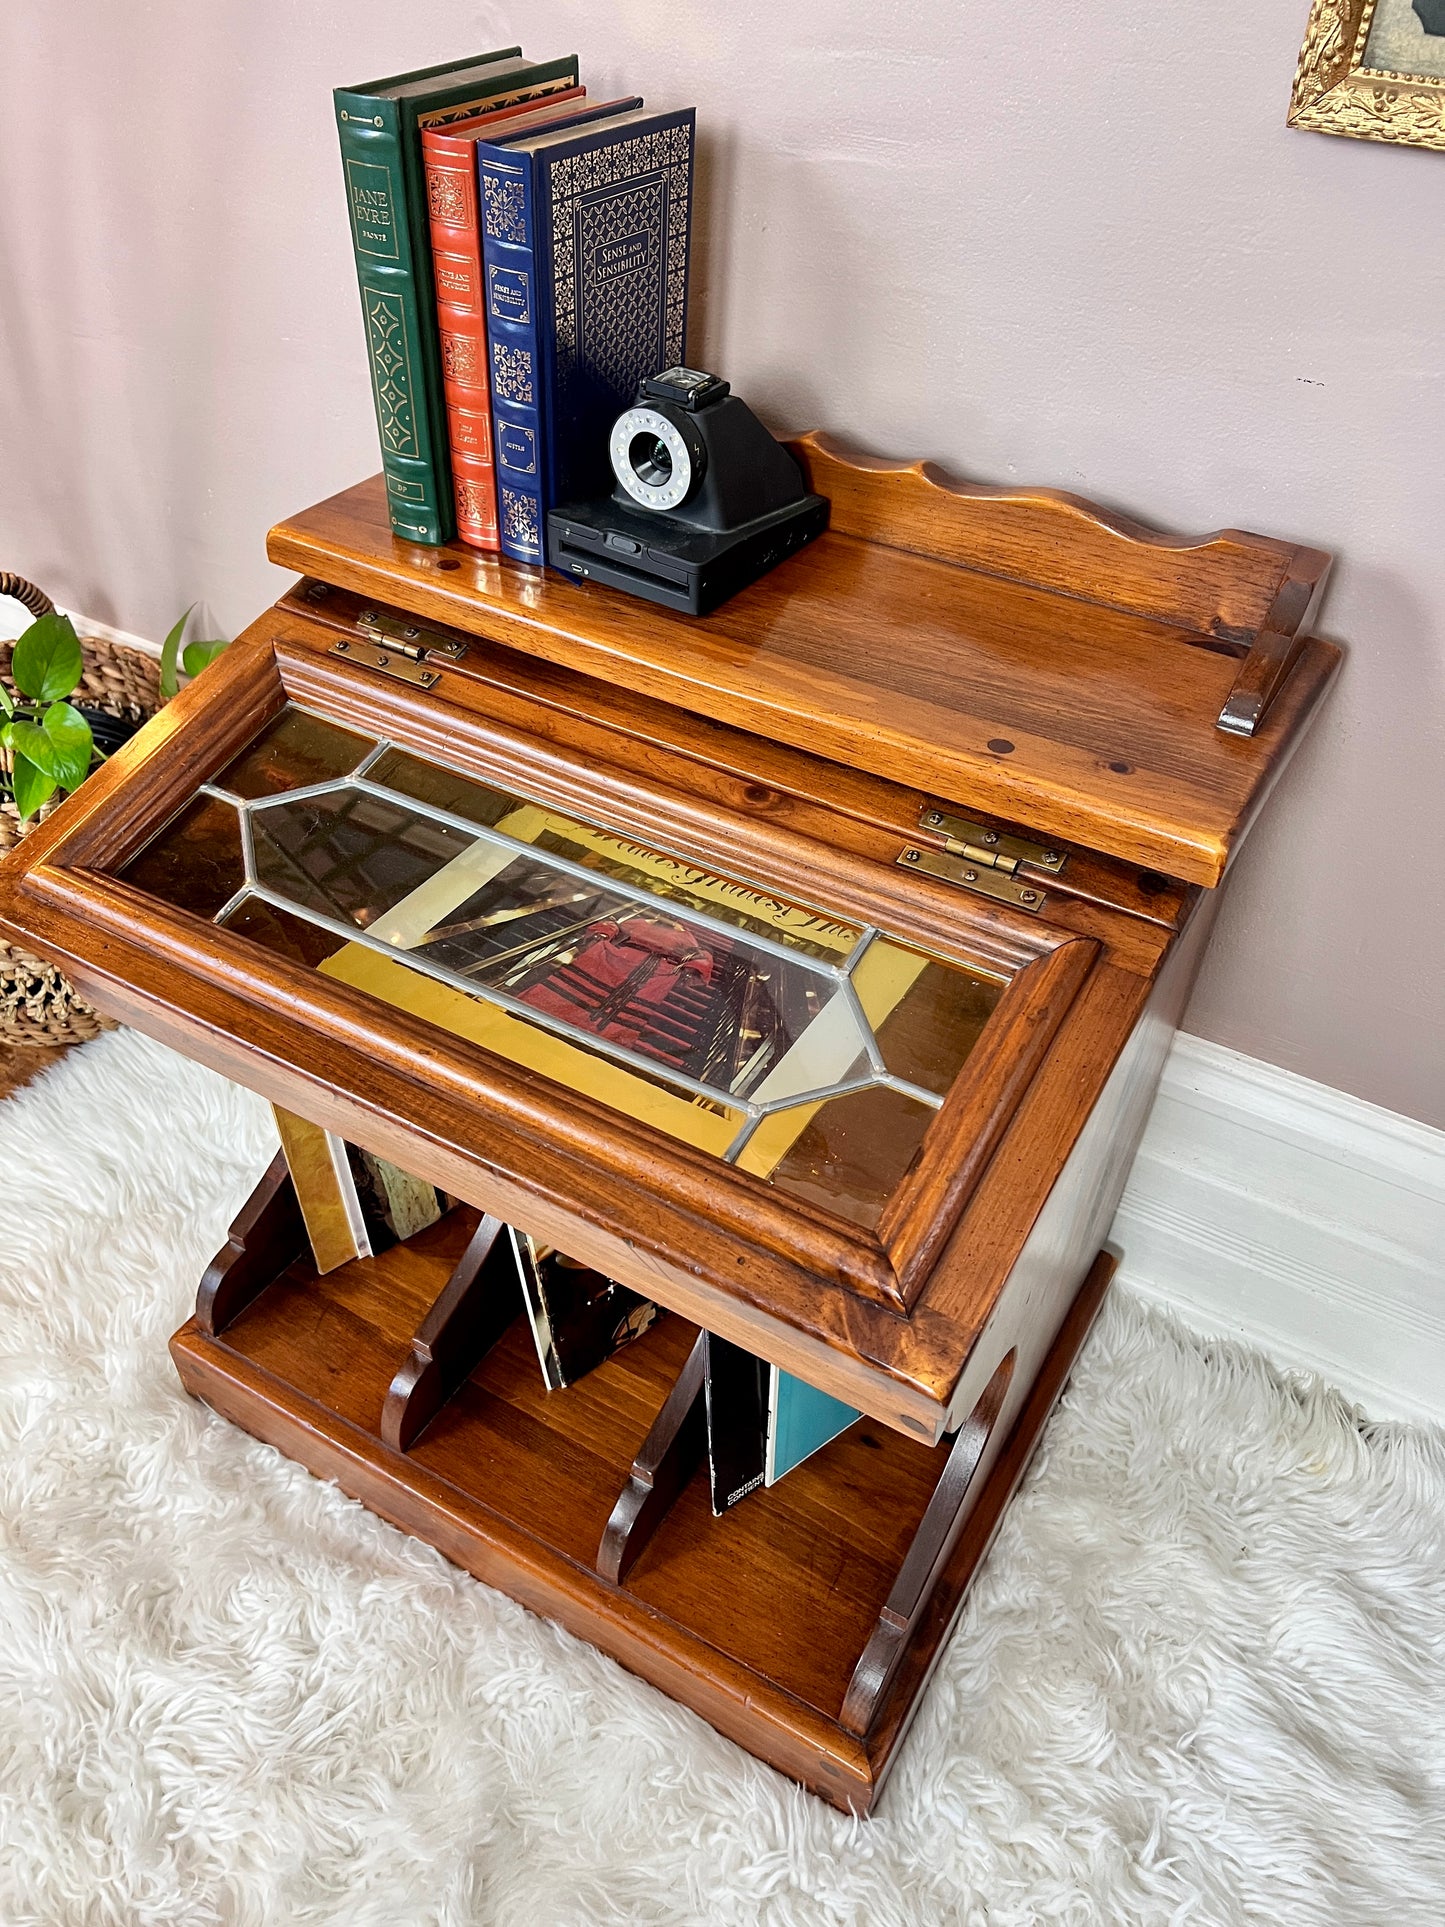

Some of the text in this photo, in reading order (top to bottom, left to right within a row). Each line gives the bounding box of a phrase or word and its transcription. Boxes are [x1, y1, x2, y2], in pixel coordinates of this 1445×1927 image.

[353, 187, 388, 206] JANE
[356, 205, 391, 225] EYRE
[602, 242, 642, 263] SENSE AND
[597, 250, 647, 280] SENSIBILITY
[727, 1471, 764, 1500] CONTAINS
